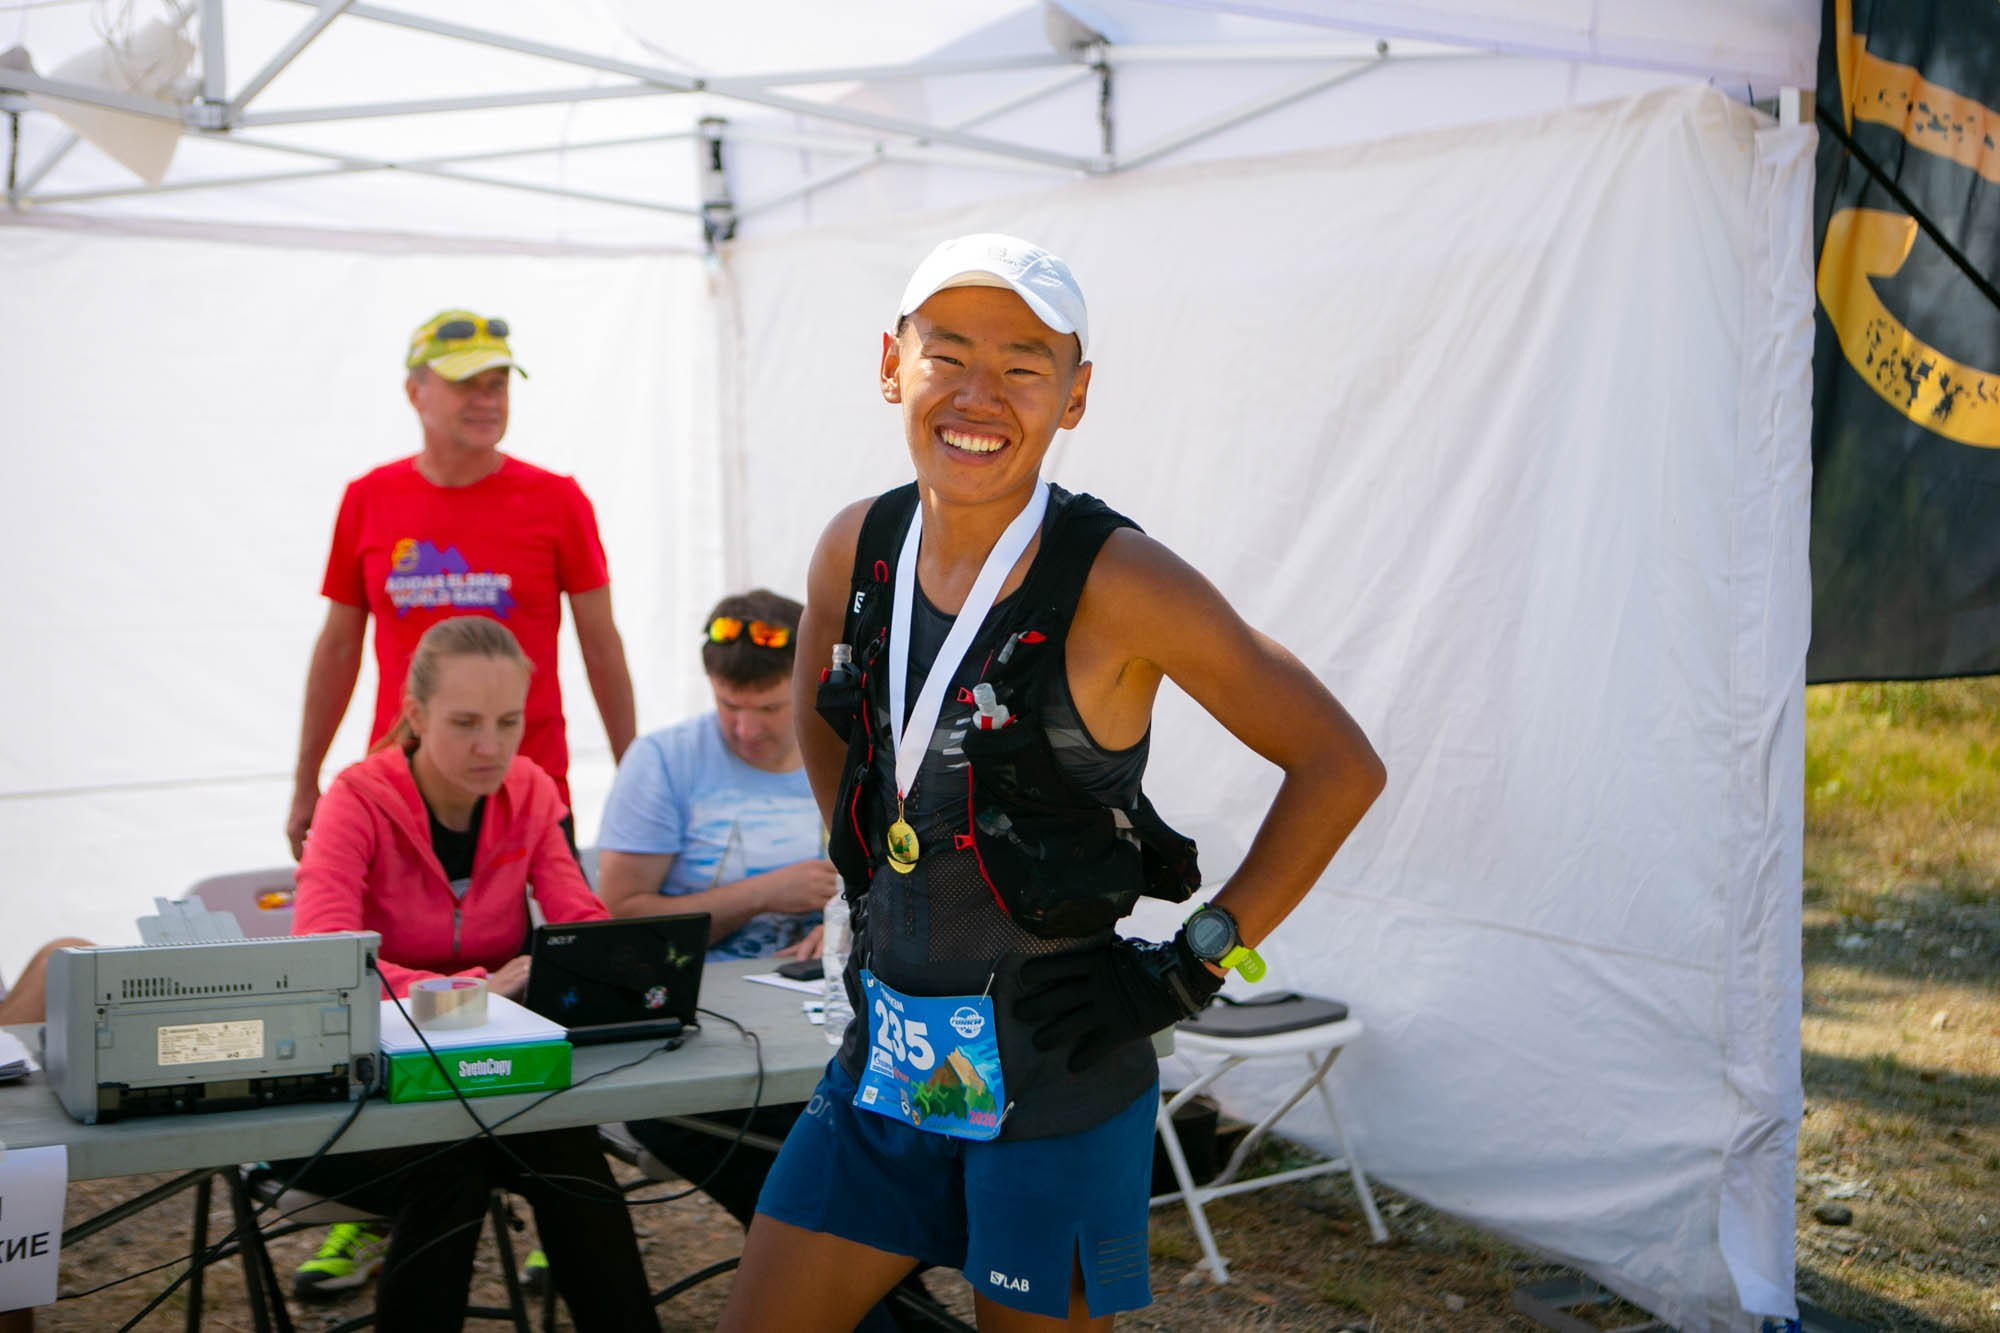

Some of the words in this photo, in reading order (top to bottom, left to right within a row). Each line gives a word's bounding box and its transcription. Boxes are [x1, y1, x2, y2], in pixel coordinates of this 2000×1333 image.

[875, 999, 936, 1070] 235
[458, 1058, 512, 1077] SvetoCopy
[969, 1110, 997, 1128] 2020
